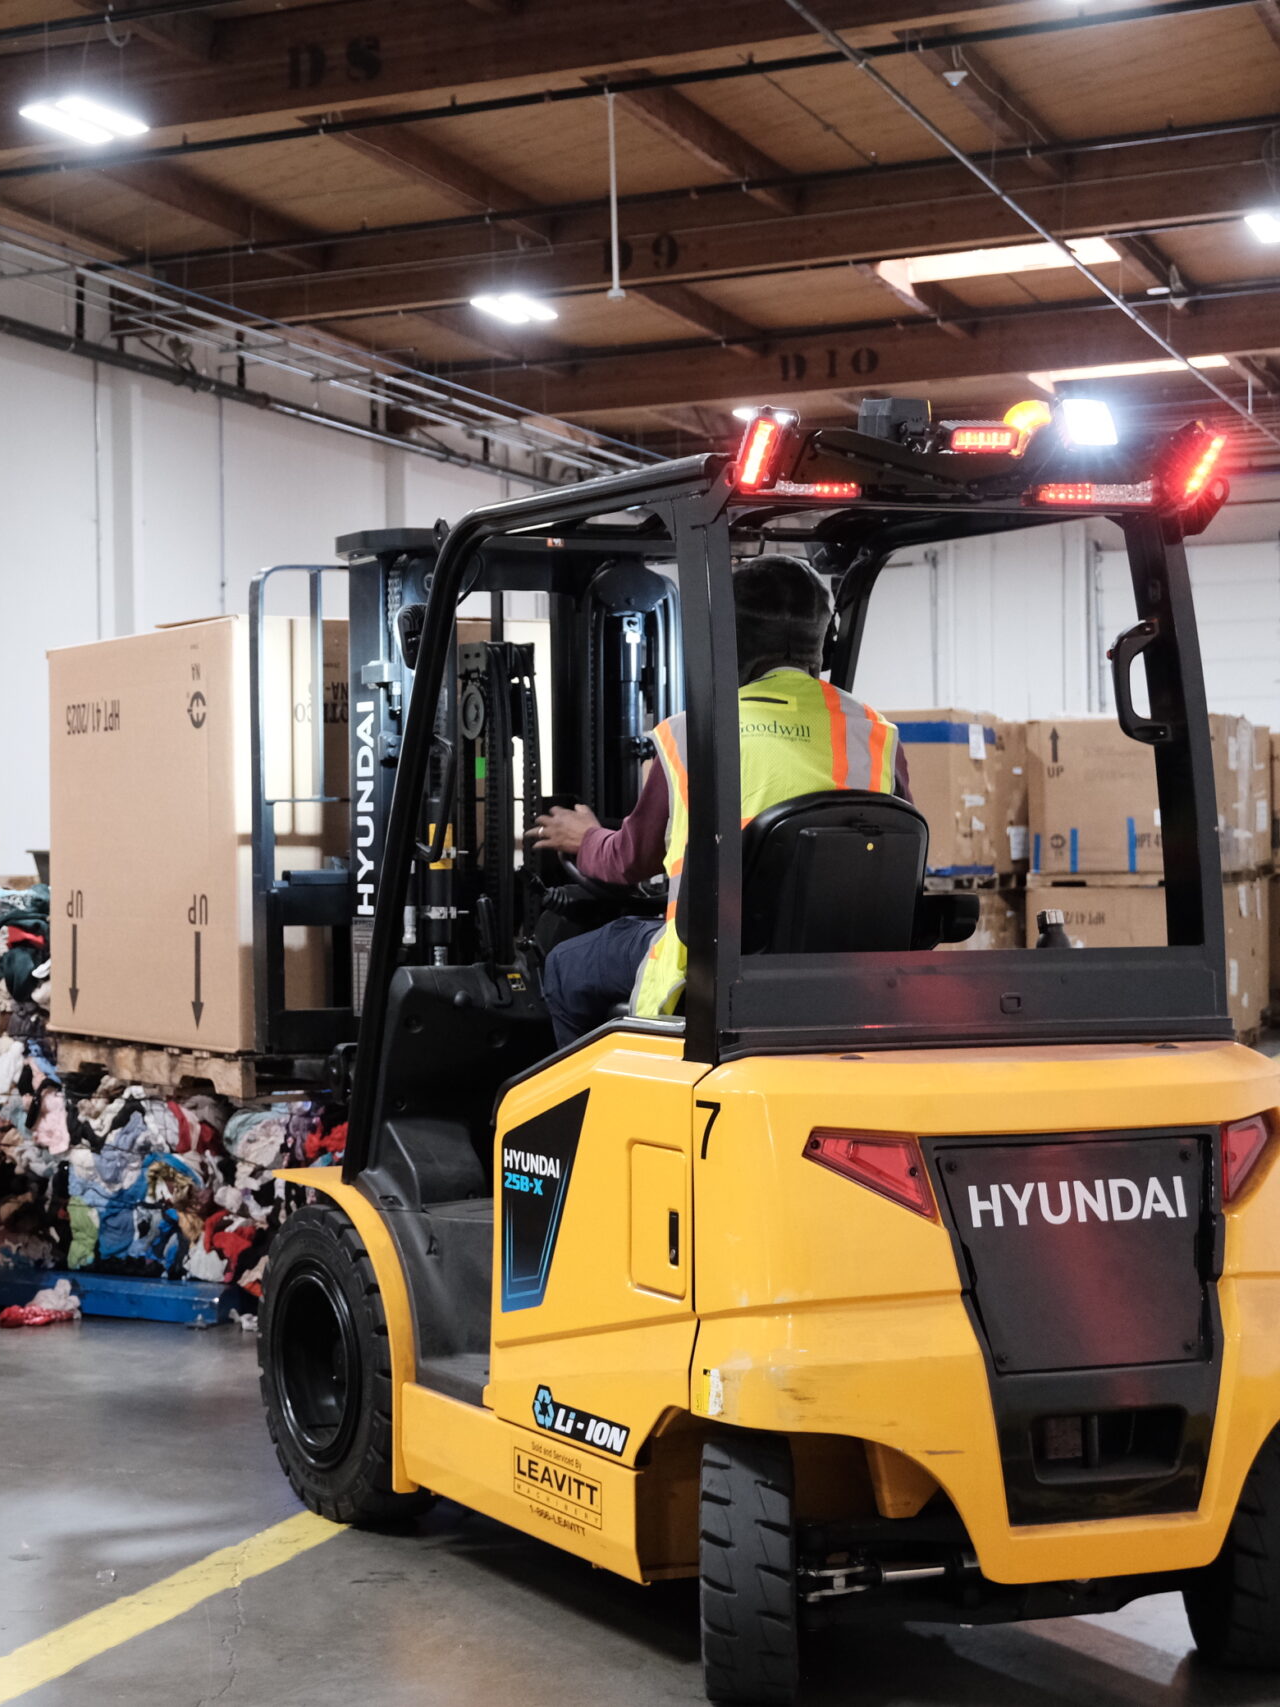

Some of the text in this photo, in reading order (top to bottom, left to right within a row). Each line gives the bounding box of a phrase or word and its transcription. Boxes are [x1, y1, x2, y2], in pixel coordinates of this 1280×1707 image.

[1047, 766, 1064, 778] UP
[356, 701, 375, 915] HYUNDAI
[66, 890, 83, 918] UP
[188, 894, 208, 925] UP
[696, 1099, 721, 1160] 7
[504, 1148, 560, 1179] HYUNDAI
[968, 1176, 1188, 1228] HYUNDAI
[517, 1454, 598, 1505] LEAVITT
